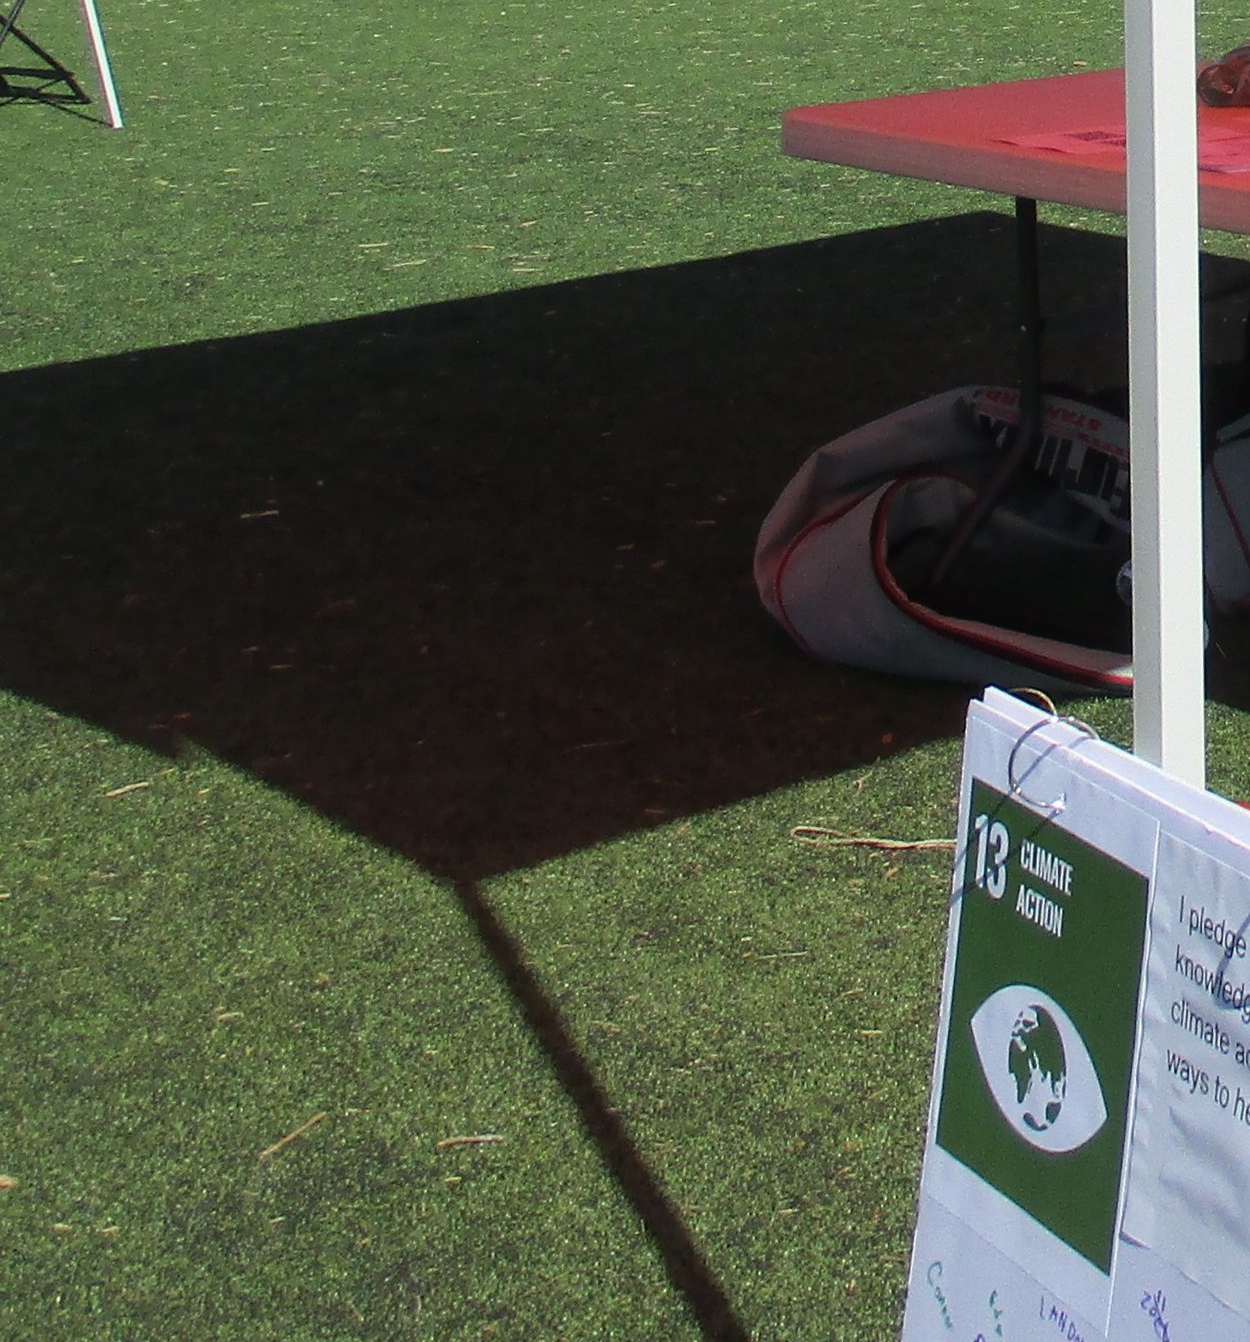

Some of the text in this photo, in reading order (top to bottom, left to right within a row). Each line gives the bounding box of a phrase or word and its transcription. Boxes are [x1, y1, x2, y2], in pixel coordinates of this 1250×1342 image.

[975, 814, 1009, 899] 13
[1021, 839, 1073, 896] CLIMATE
[1016, 884, 1063, 938] ACTION
[1189, 907, 1247, 958] pledge
[1171, 999, 1230, 1054] climate
[1166, 1049, 1209, 1095] ways
[1214, 1075, 1230, 1108] to
